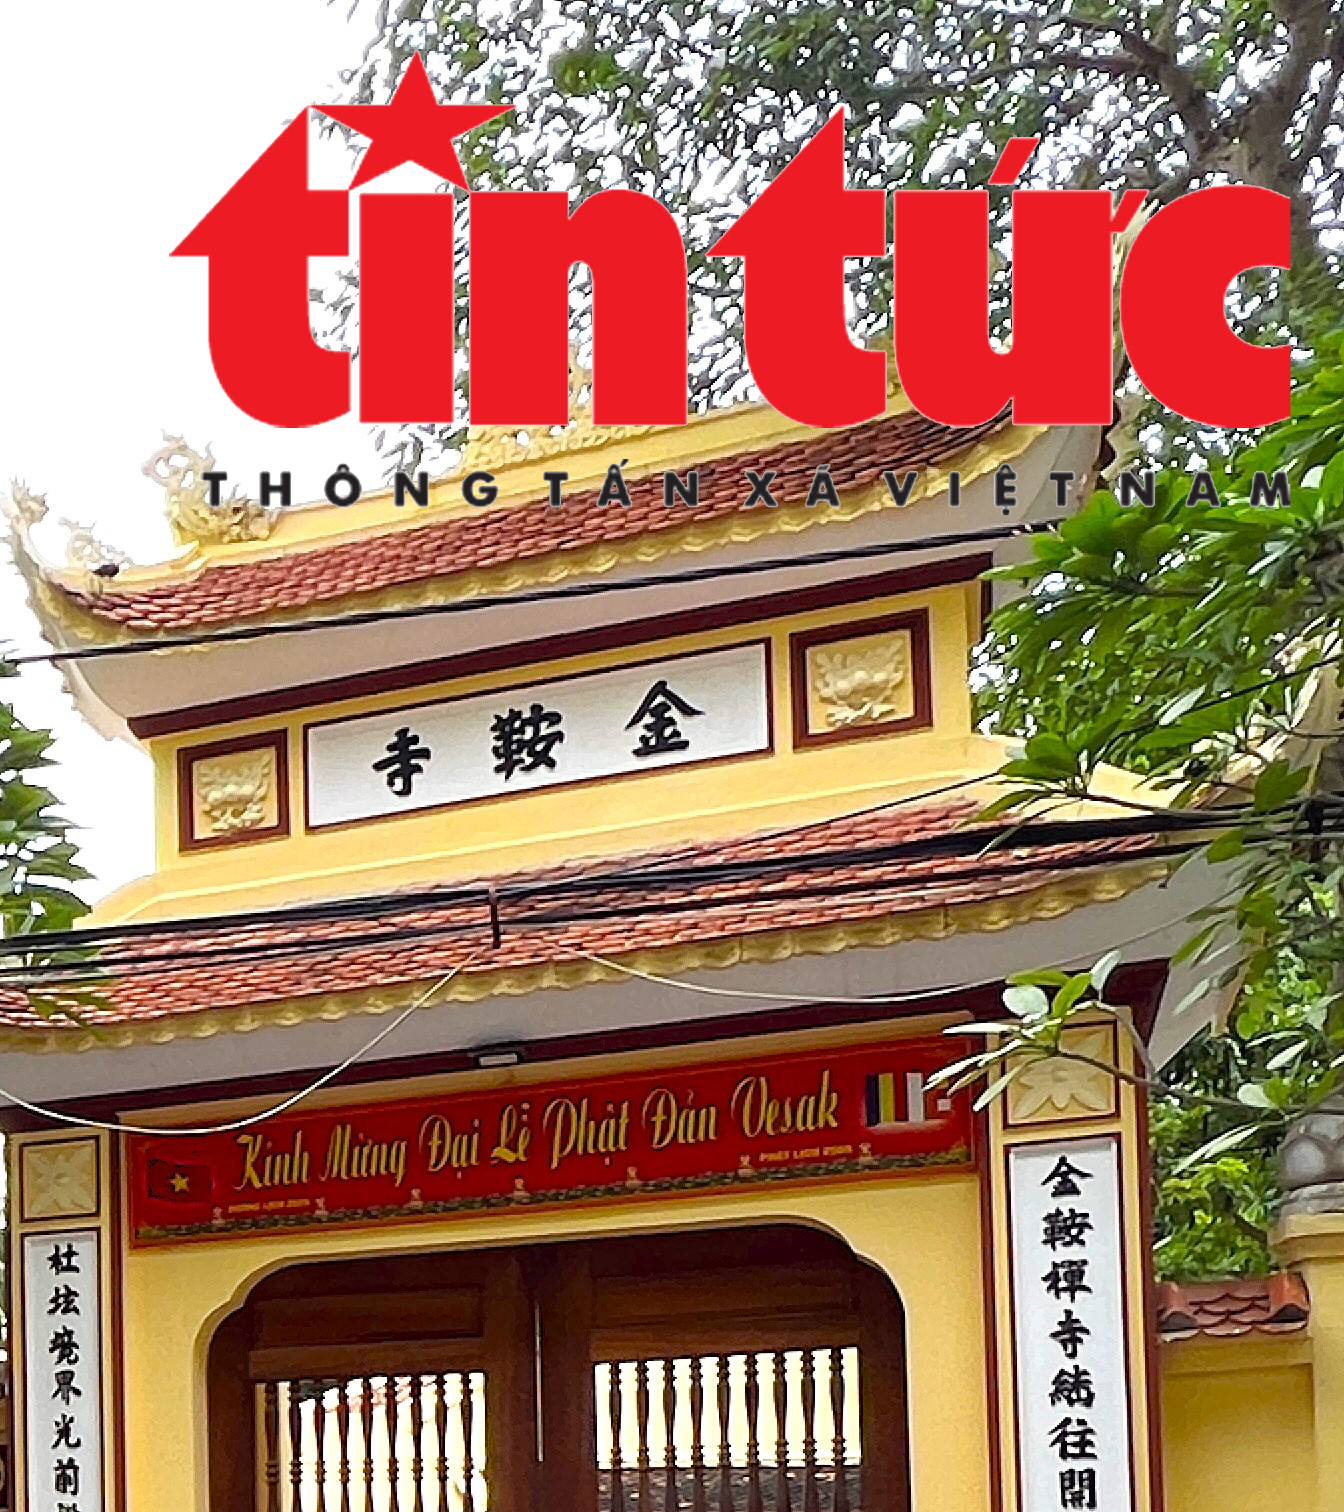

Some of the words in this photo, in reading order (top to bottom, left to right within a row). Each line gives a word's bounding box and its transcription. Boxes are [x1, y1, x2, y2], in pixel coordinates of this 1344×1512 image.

[418, 1114, 480, 1179] Đại
[642, 1087, 718, 1149] Đản
[731, 1069, 838, 1137] Vesak
